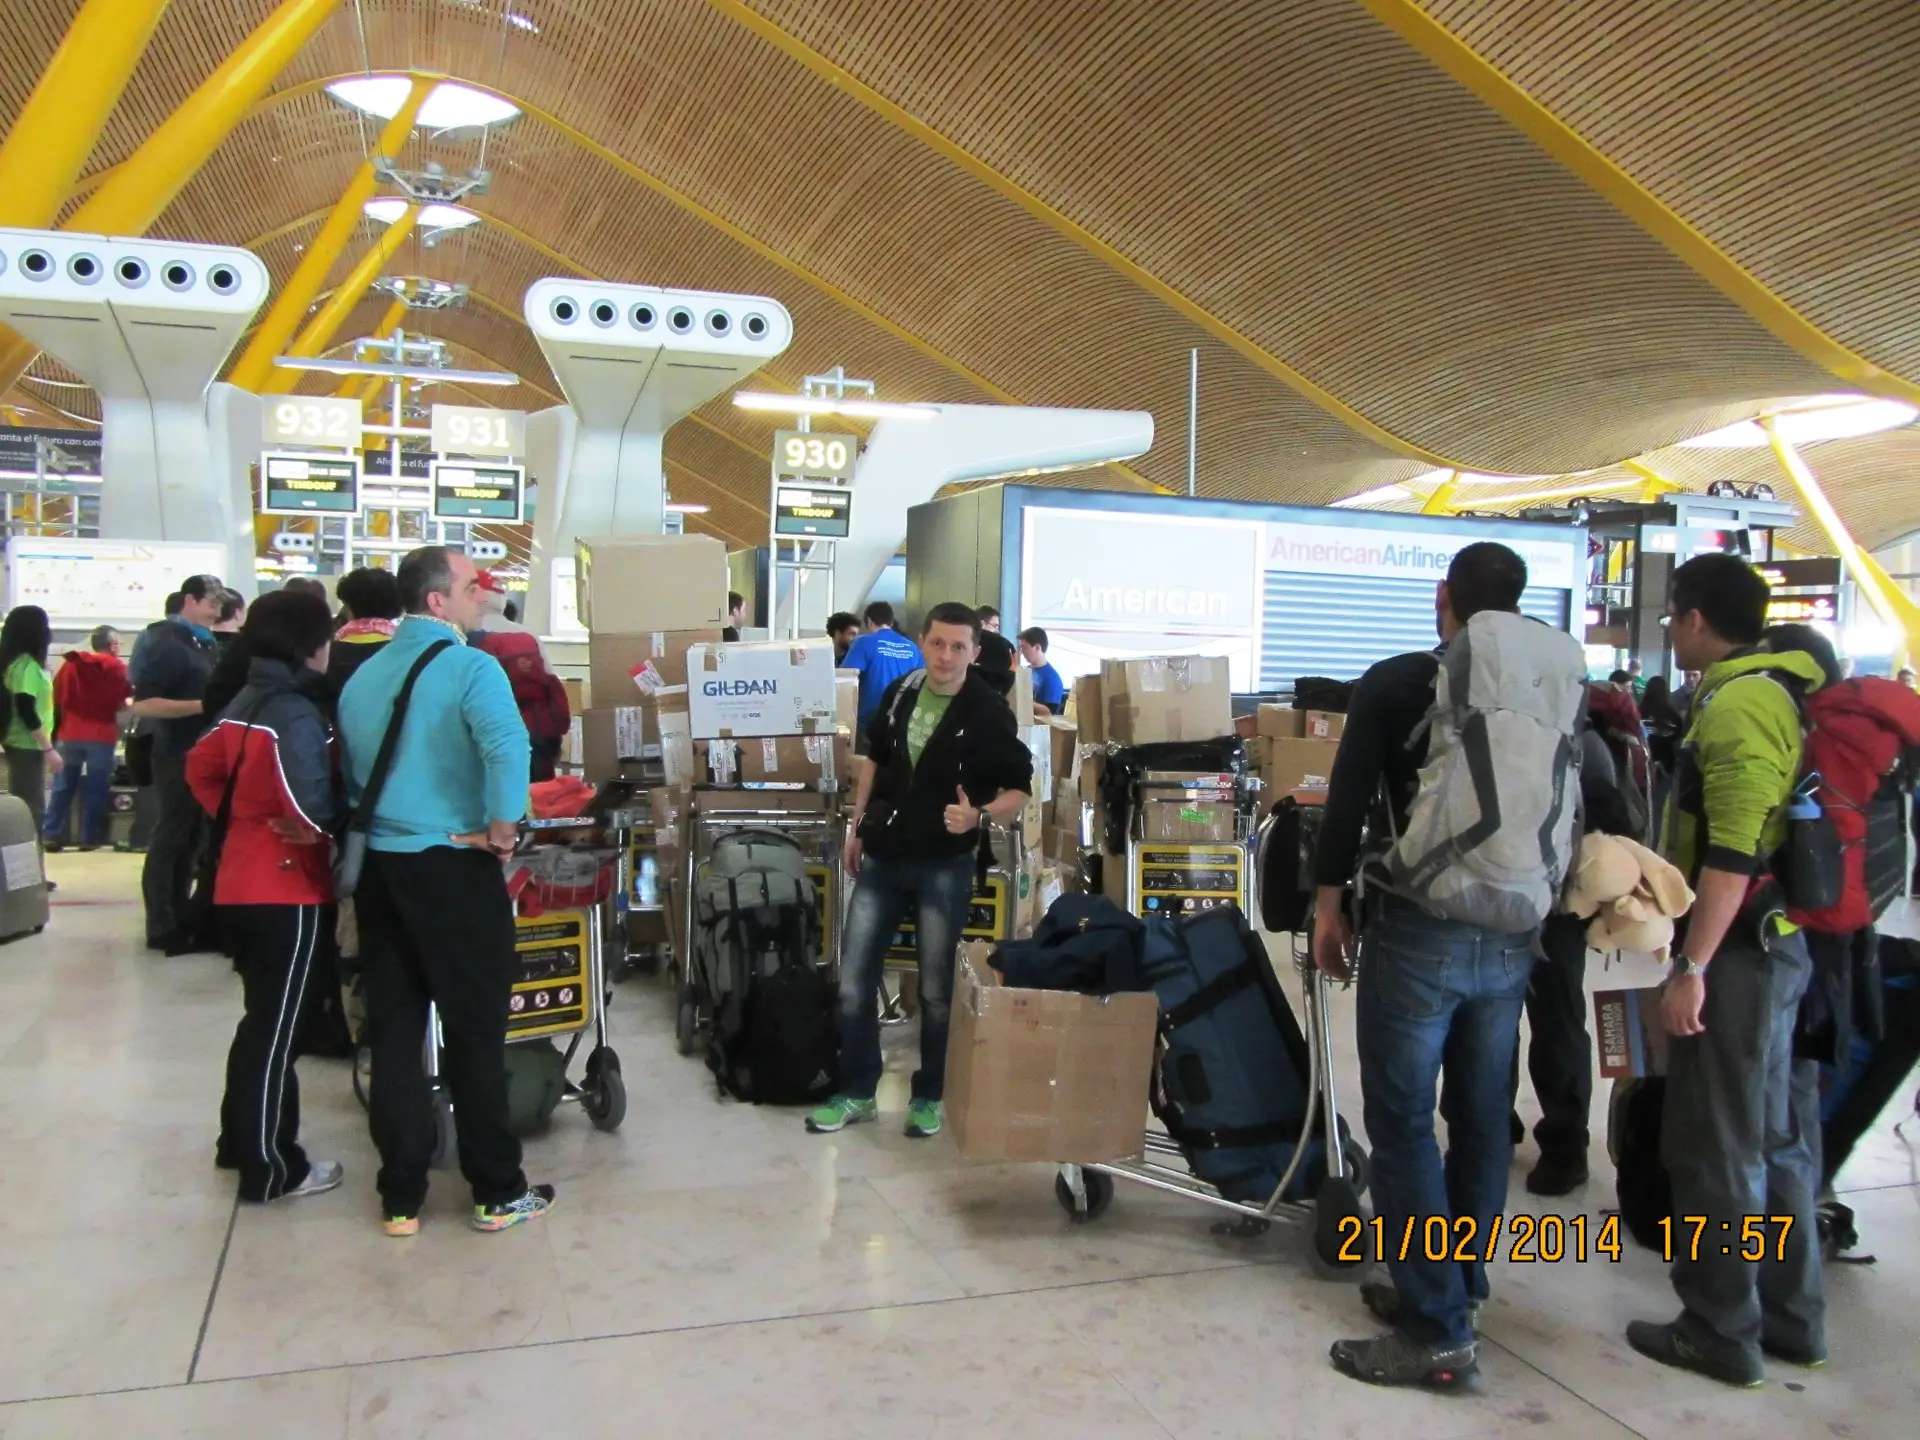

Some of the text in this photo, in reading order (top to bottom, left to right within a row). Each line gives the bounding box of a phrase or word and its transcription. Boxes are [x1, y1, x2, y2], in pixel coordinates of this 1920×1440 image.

[277, 403, 349, 437] 932
[447, 414, 510, 448] 931
[786, 438, 847, 470] 930
[1061, 576, 1228, 616] American
[702, 679, 777, 697] GILDAN
[1602, 1003, 1616, 1054] SAHARA
